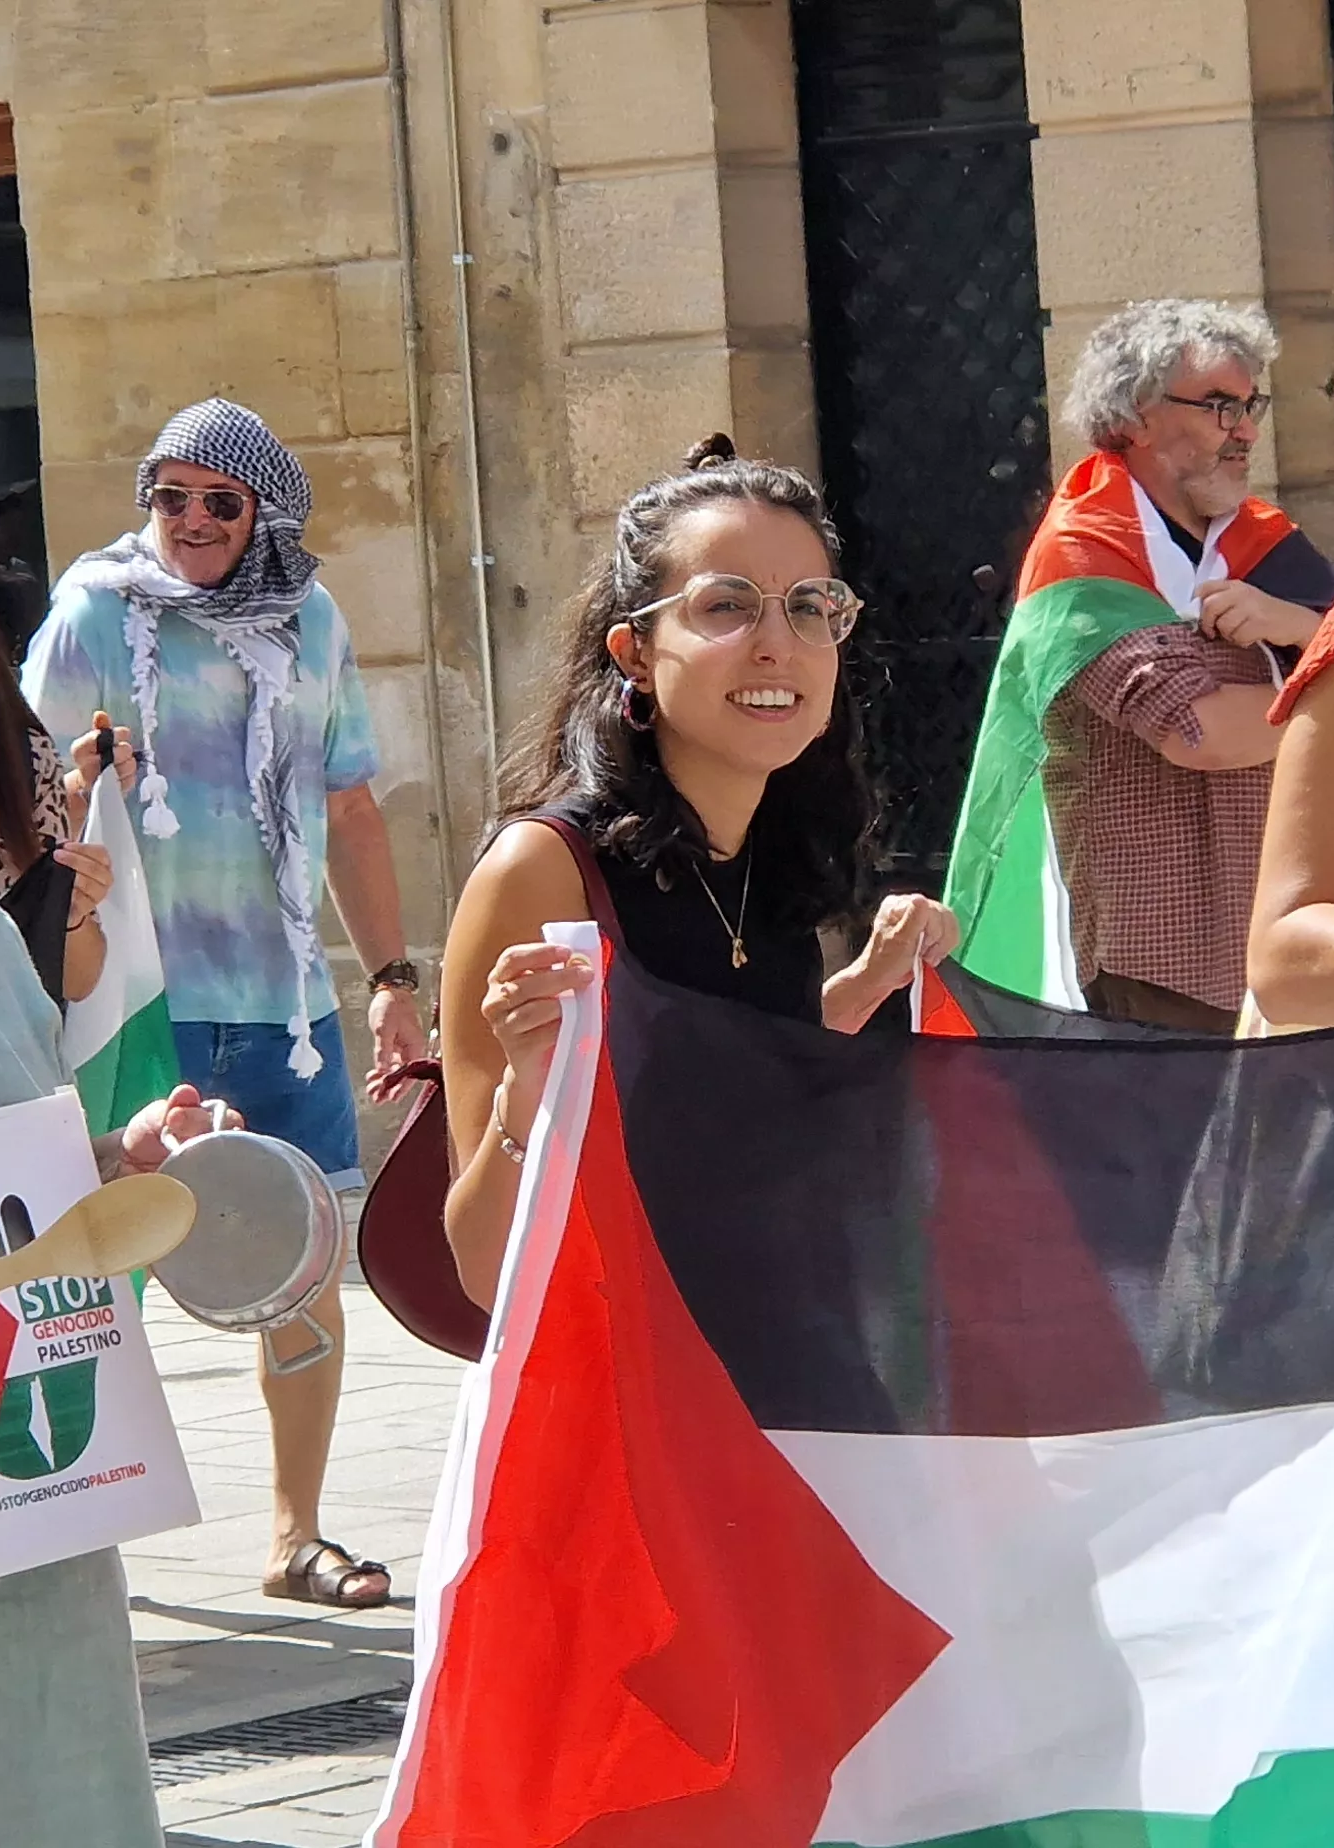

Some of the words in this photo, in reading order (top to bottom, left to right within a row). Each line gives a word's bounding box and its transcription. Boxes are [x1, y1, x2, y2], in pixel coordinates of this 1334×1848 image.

[19, 1275, 107, 1319] STOP
[33, 1307, 115, 1340] GENOCIDIO
[37, 1329, 122, 1363] PALESTINO
